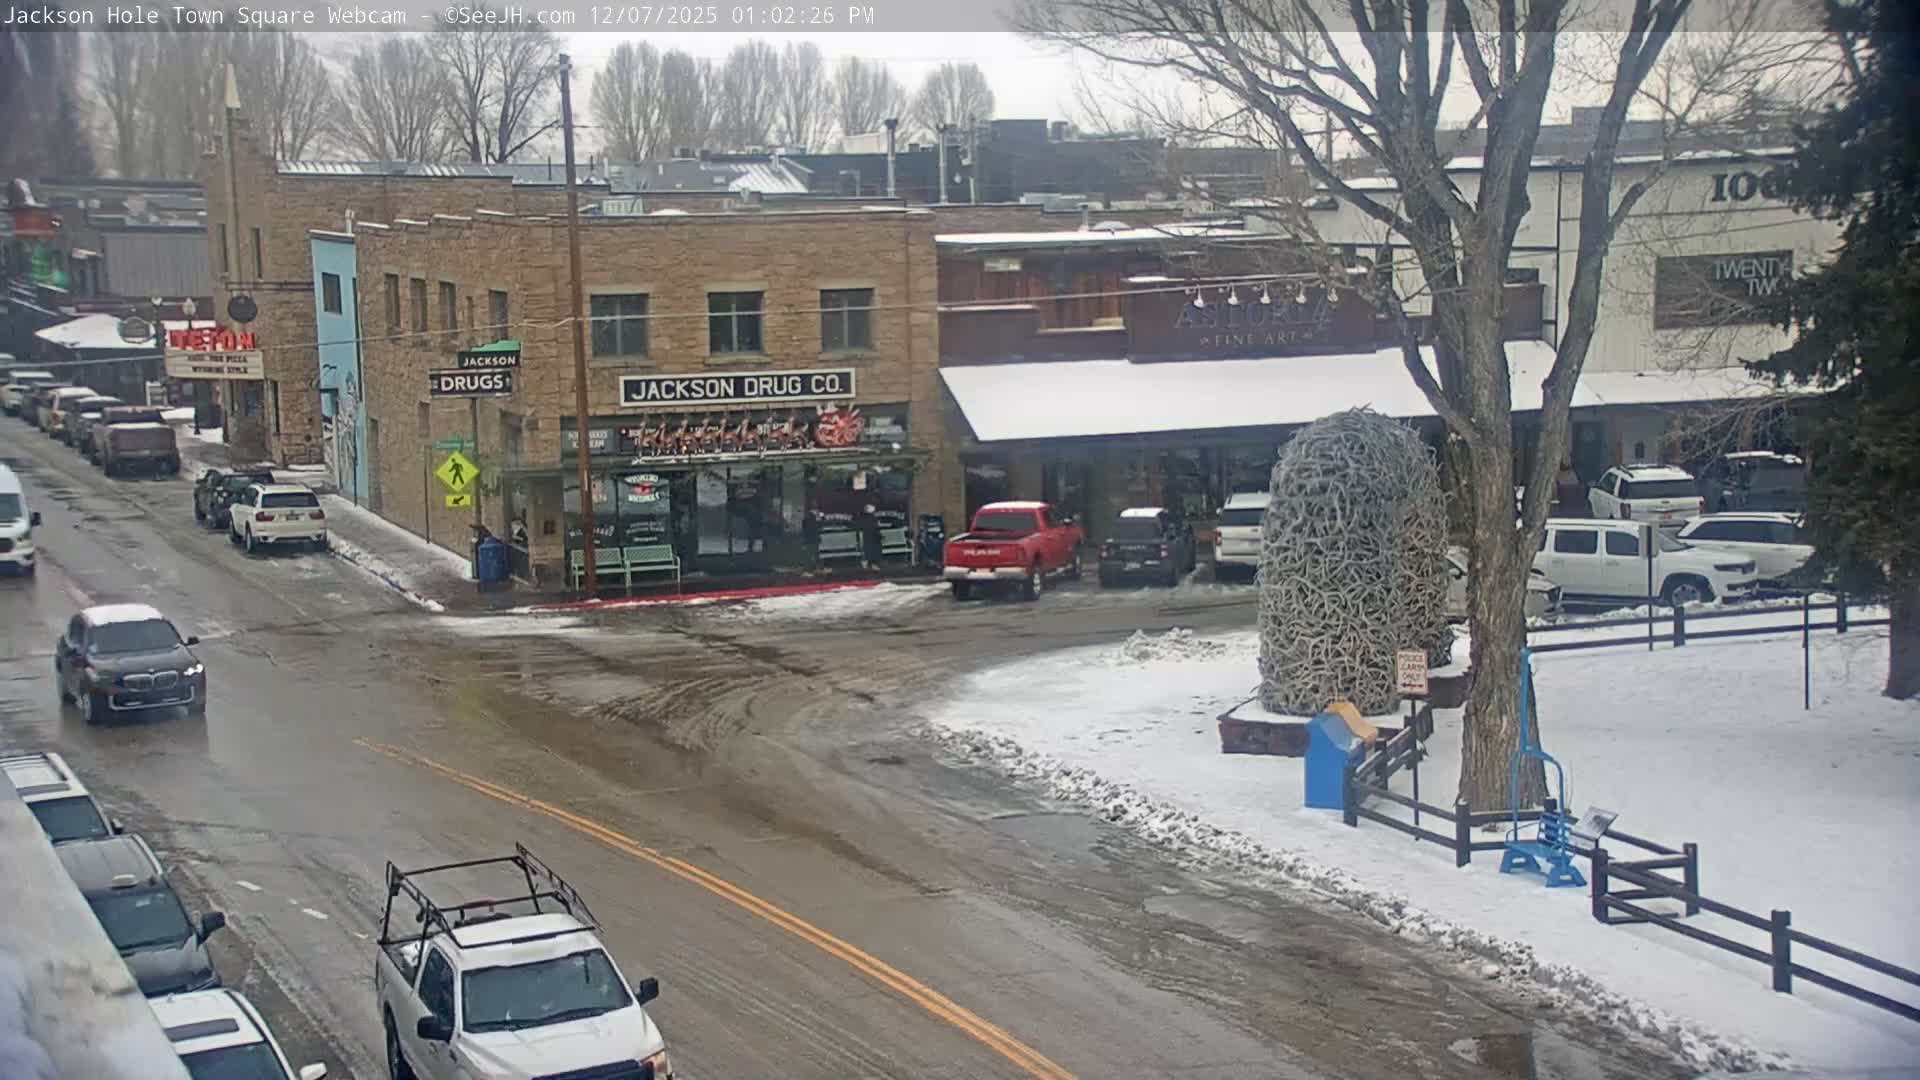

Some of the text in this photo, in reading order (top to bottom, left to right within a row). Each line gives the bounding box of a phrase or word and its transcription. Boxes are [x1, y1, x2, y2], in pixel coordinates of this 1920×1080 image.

[168, 326, 257, 350] TETON
[1215, 331, 1297, 347] FINE ART
[463, 356, 517, 367] JACKSON
[440, 375, 504, 391] DRUGS
[632, 374, 844, 400] JACKSON DRUG CO.
